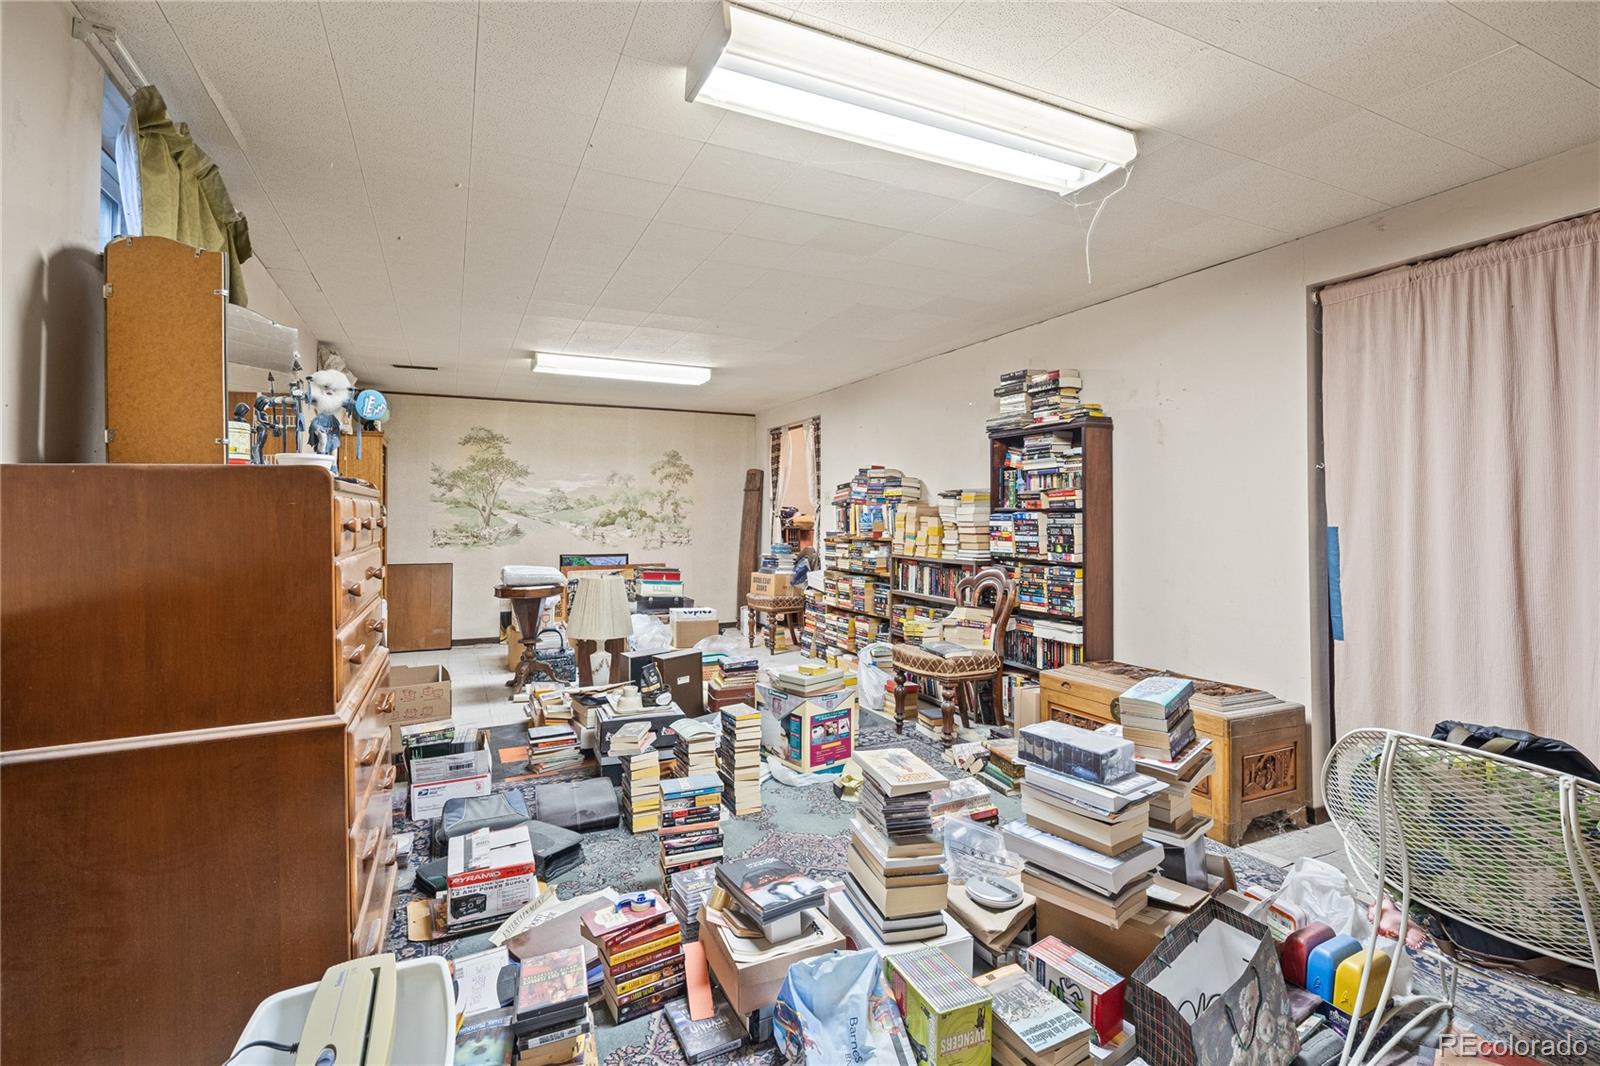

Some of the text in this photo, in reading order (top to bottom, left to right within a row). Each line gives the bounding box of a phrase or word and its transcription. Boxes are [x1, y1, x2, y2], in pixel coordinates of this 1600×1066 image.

[451, 871, 501, 885] PYRAMID
[849, 1017, 863, 1063] Barnes
[941, 1027, 985, 1054] AVENGERS
[1026, 1030, 1057, 1044] Malaya
